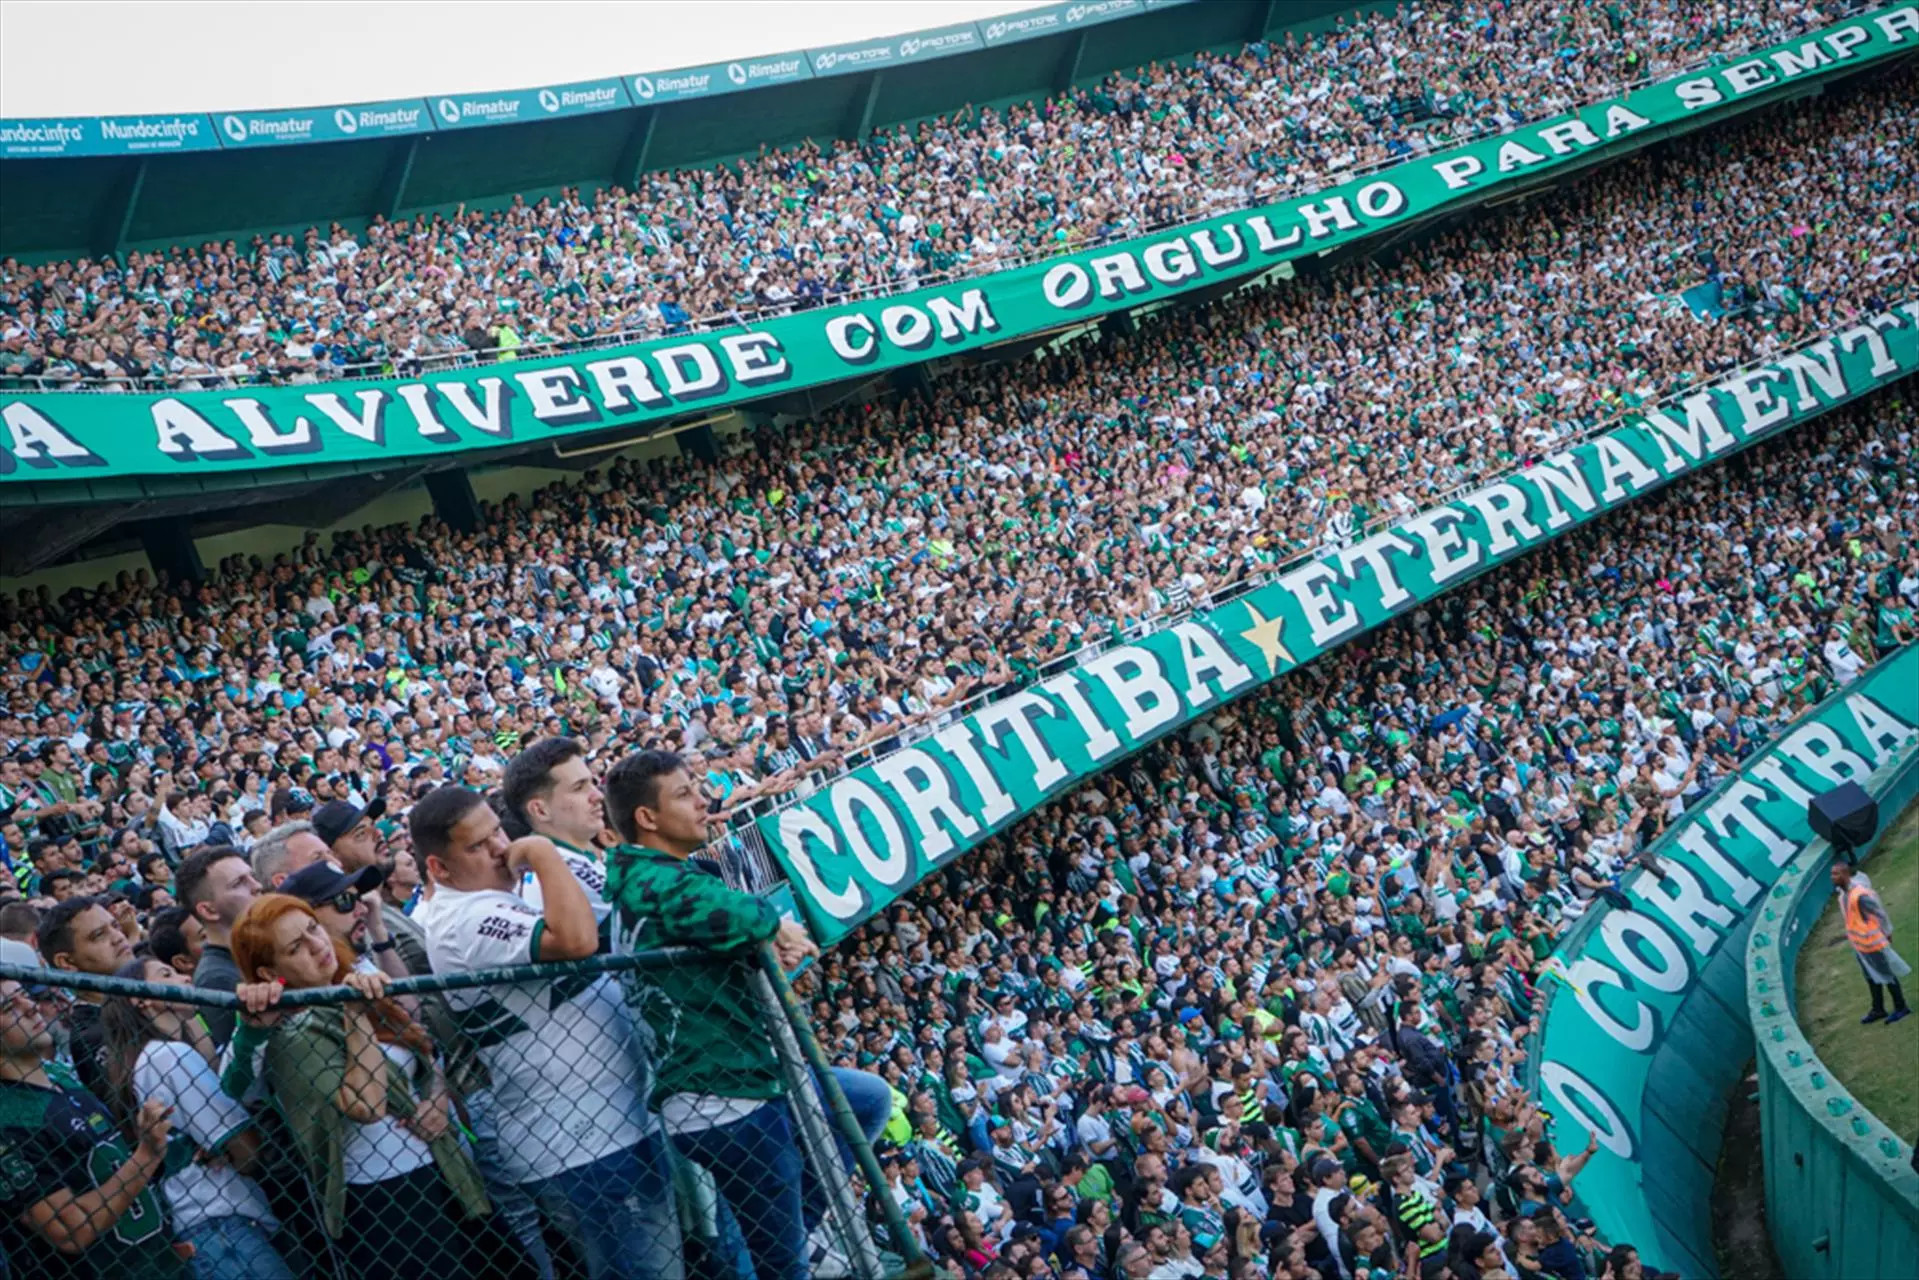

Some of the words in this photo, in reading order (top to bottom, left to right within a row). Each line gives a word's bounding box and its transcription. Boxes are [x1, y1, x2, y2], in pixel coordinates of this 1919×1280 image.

[749, 60, 800, 78] Rimatur
[657, 74, 710, 92] Rimatur
[561, 88, 617, 106] Rimatur
[463, 99, 520, 116] Rimatur
[250, 118, 314, 135] Rimatur
[360, 109, 420, 127] Rimatur
[1, 401, 95, 461] A
[152, 331, 790, 458] ALVIVERDE
[825, 289, 997, 360] COM
[1042, 181, 1404, 308] ORGULHO
[1431, 105, 1650, 191] PARA
[1675, 7, 1919, 110] SEMPR
[780, 622, 1253, 920] CORITIBA
[1280, 301, 1919, 646] ETERNAMENT
[1566, 692, 1918, 1052] CORITIBA
[1541, 1060, 1634, 1160] O
